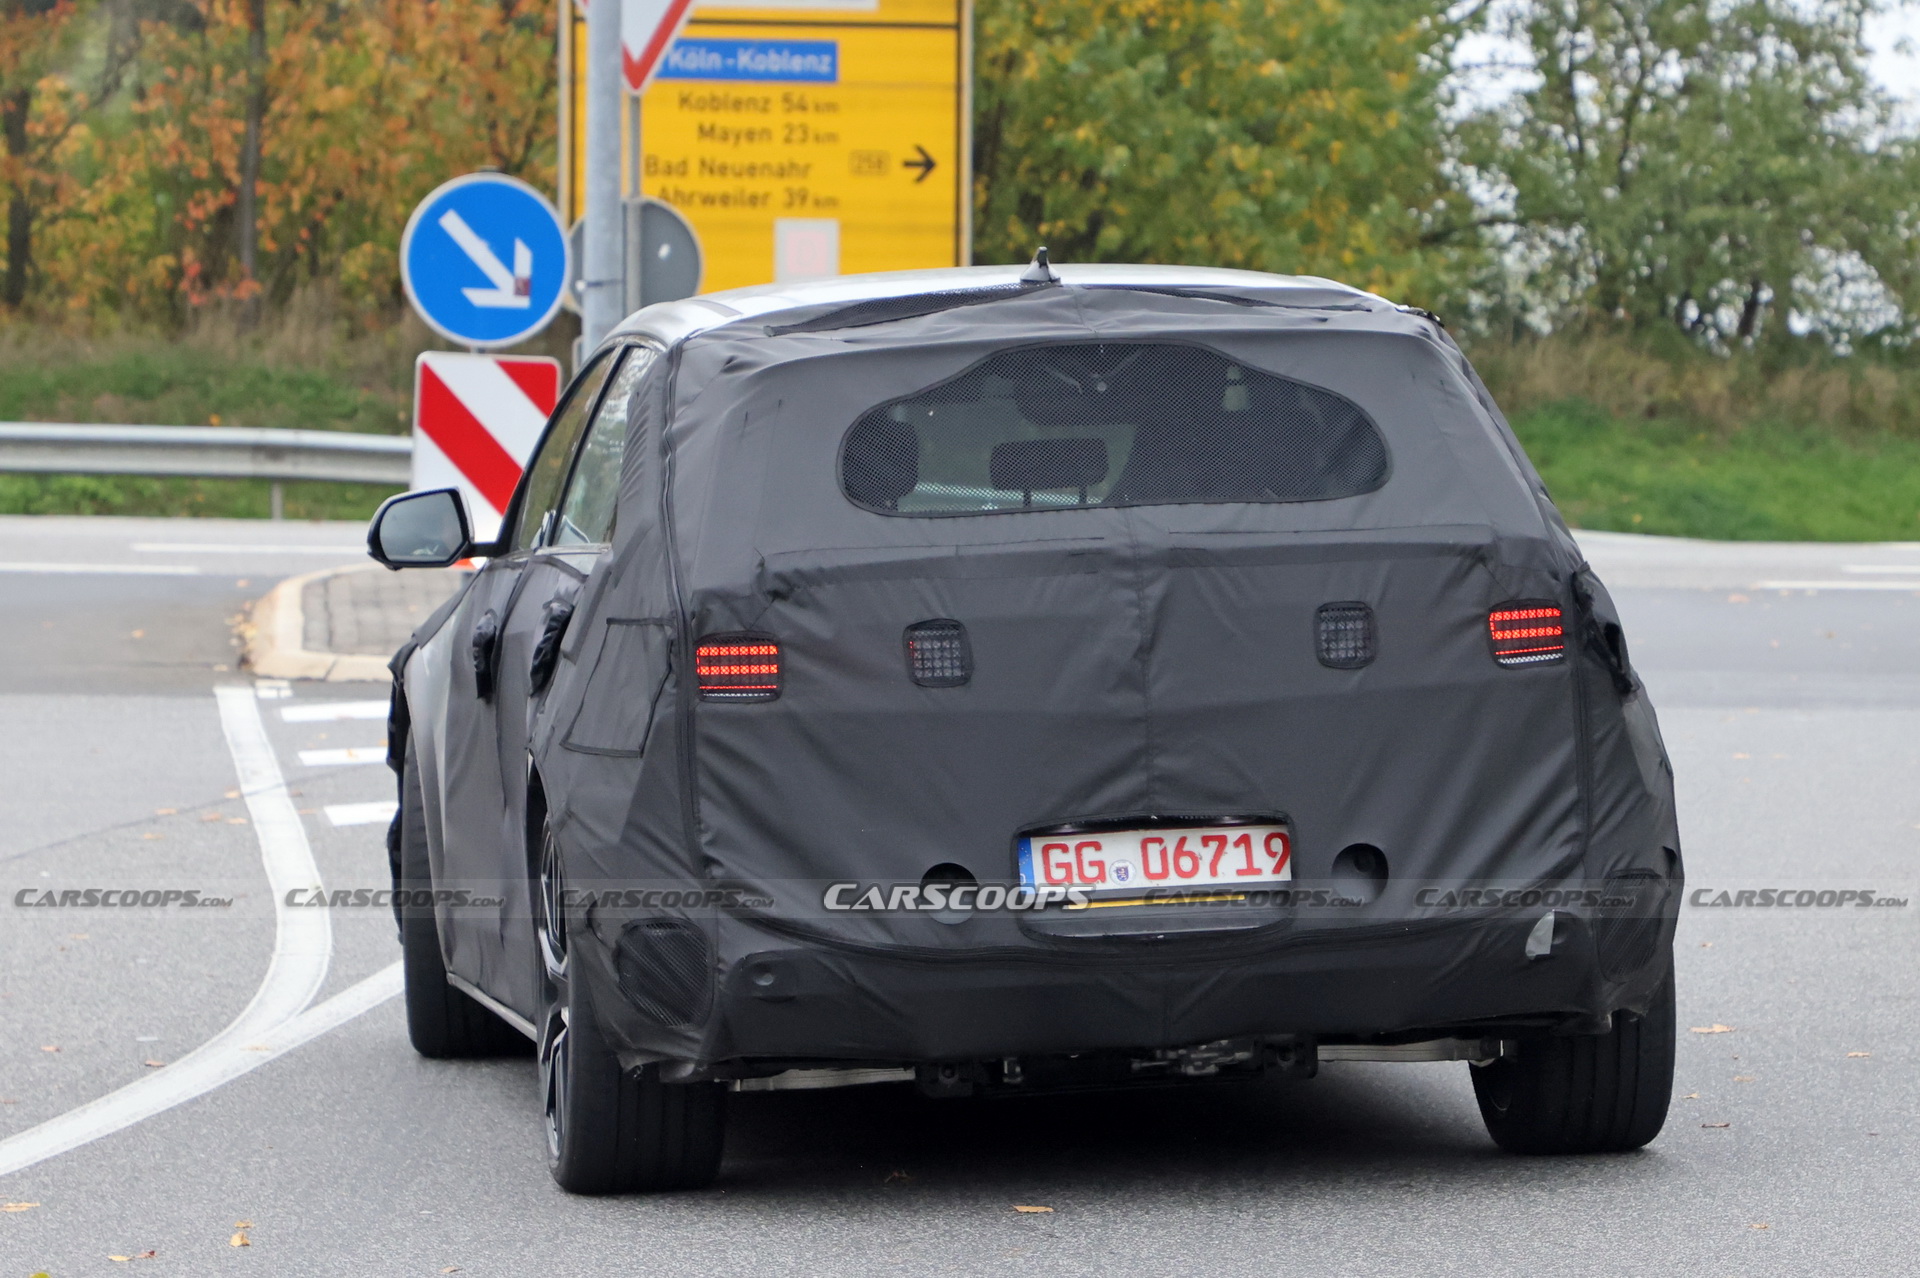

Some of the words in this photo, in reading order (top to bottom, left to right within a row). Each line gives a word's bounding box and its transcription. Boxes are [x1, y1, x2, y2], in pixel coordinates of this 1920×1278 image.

[678, 91, 771, 113] Koblenz
[782, 92, 809, 113] 54
[814, 101, 840, 113] km
[697, 123, 773, 148] Mayen
[784, 123, 809, 144] 23
[814, 132, 839, 143] km
[644, 155, 689, 177] Bad
[699, 158, 812, 179] Neuenahr
[659, 187, 770, 208] Ahrweiler
[784, 187, 809, 208] 39
[814, 197, 839, 209] km
[1041, 841, 1107, 886] GG
[1140, 832, 1292, 881] 06719
